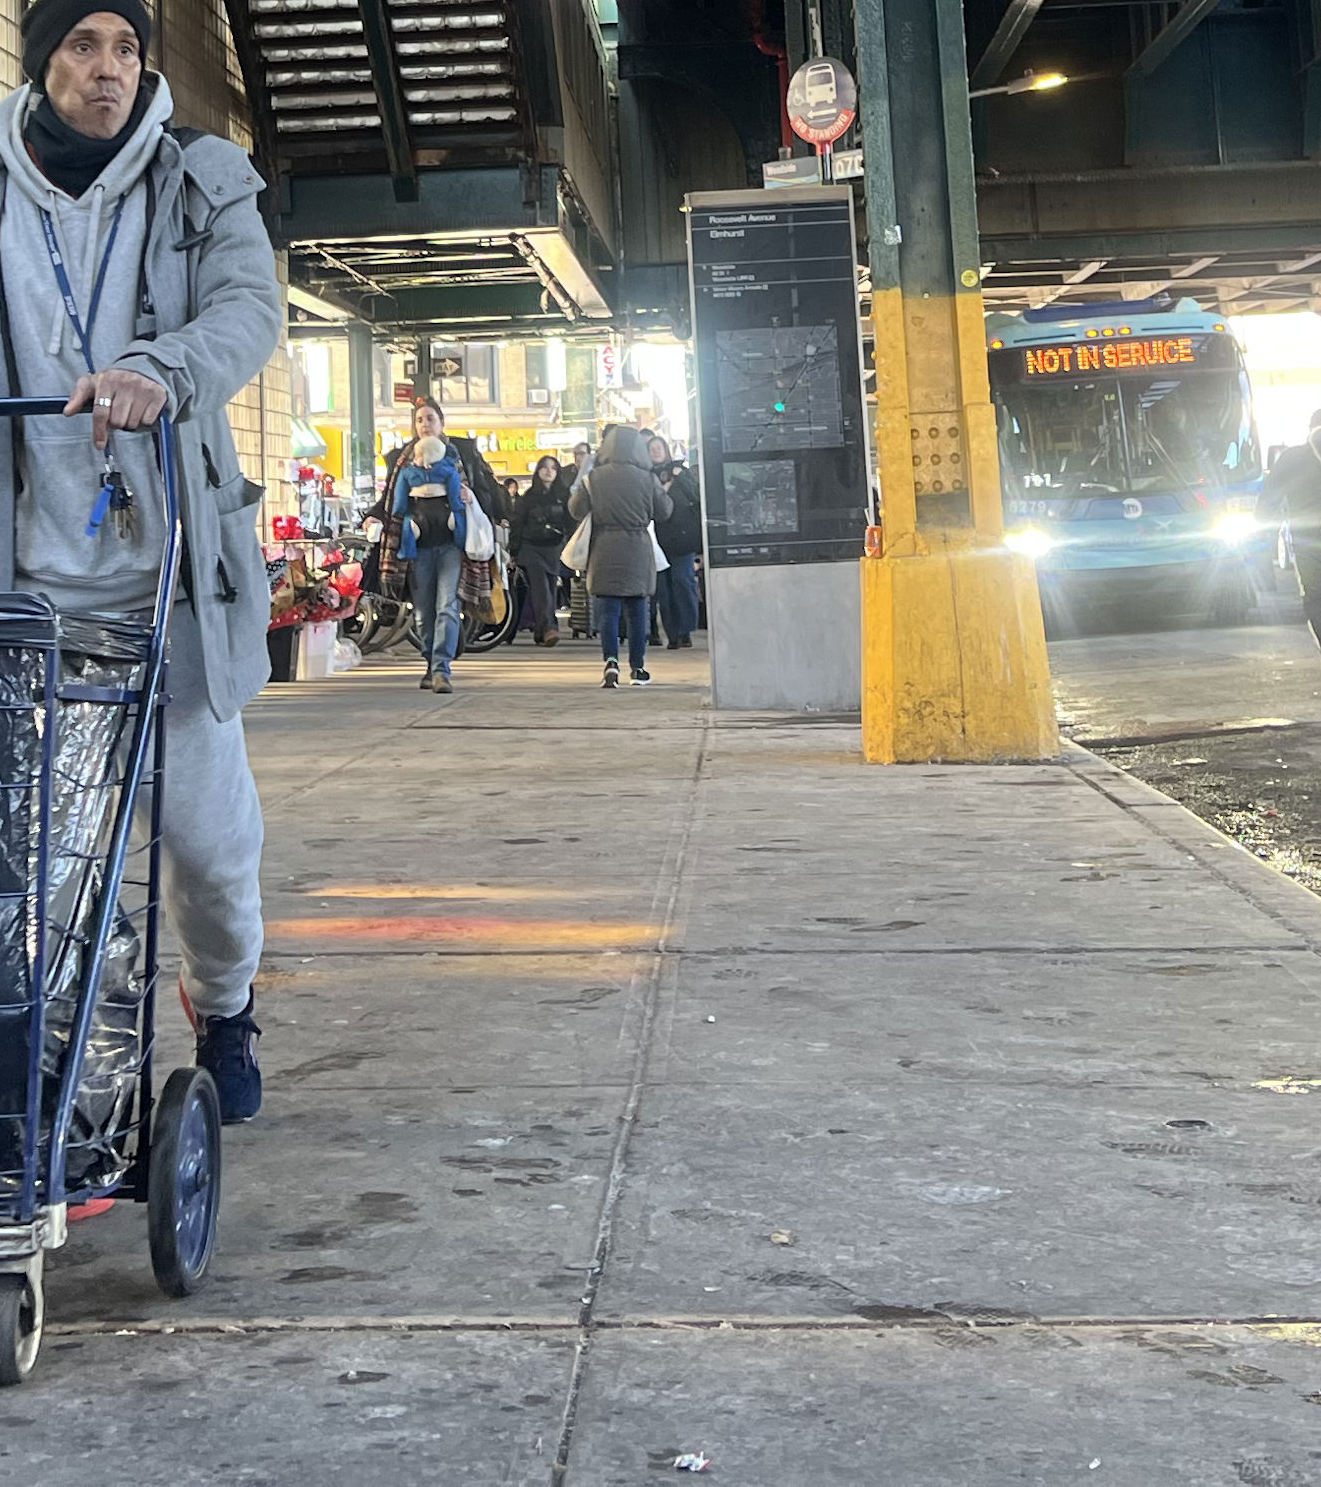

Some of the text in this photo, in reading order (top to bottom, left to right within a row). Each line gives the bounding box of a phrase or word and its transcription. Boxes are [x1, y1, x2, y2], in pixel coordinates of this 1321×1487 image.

[808, 113, 849, 140] STANDING
[1025, 347, 1073, 375] NOT
[1077, 345, 1102, 371] IN
